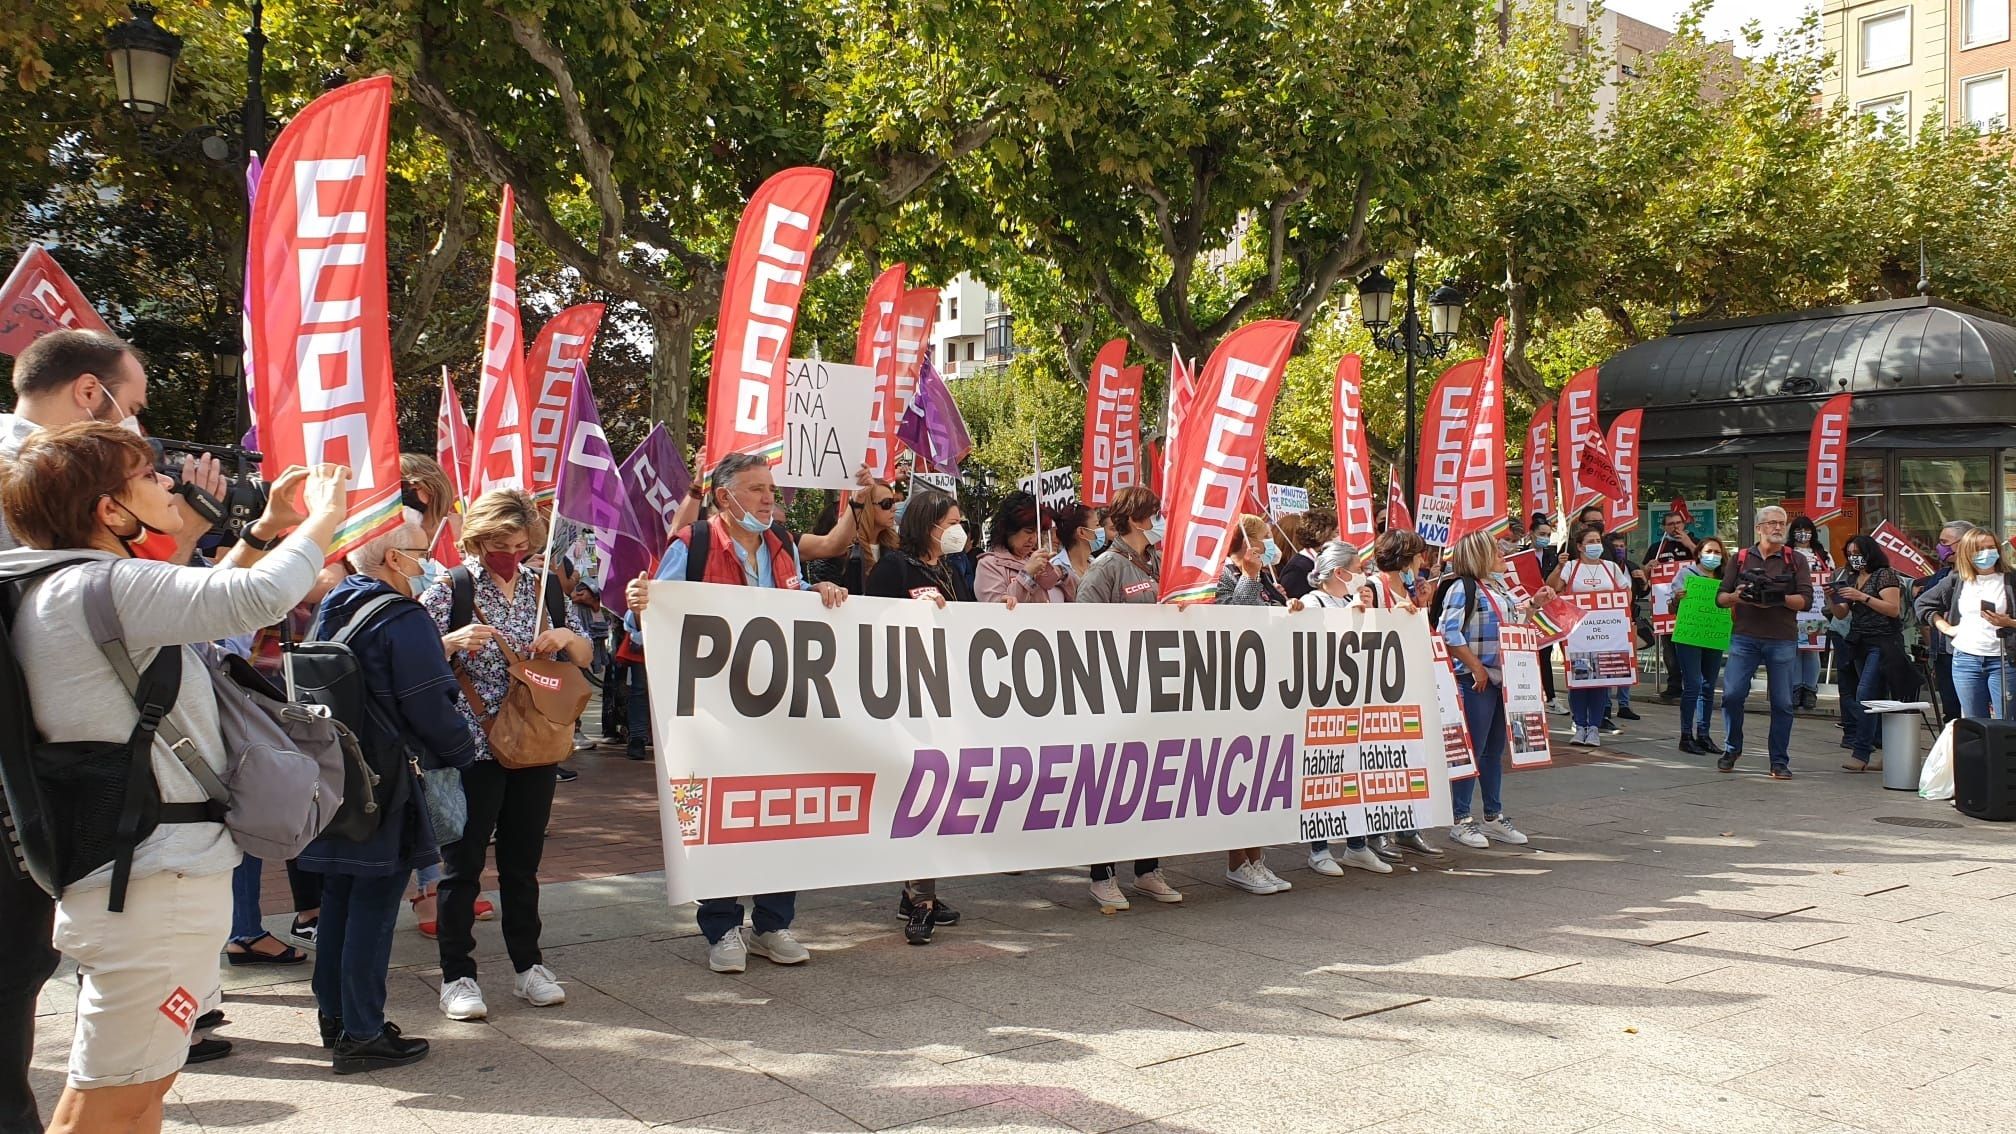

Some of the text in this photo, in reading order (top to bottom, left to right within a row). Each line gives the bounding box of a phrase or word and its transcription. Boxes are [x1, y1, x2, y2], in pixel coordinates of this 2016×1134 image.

[294, 154, 375, 491] CCOO
[734, 202, 810, 435] CCOO
[784, 364, 830, 390] SAD
[786, 422, 849, 479] INA
[1092, 364, 1118, 504] CCOO
[1112, 387, 1135, 491] CCOO
[1181, 356, 1270, 577] CCOO
[1341, 377, 1374, 535] CCOO
[1530, 422, 1549, 514] CCOO
[1816, 414, 1843, 508] CCOO
[1022, 471, 1074, 496] CUDADOS
[1418, 521, 1449, 544] MAYO
[1436, 513, 1450, 525] NUE
[1874, 531, 1925, 566] CCOO
[1125, 582, 1151, 595] CCOO
[1499, 626, 1538, 651] CCOO
[1580, 618, 1622, 626] UALIZACIÓN
[524, 669, 560, 687] CCOO
[677, 614, 1406, 720] POR UN CONVENIO JUSTO
[1308, 712, 1400, 738] CCOO CCOO
[1302, 744, 1408, 776] hábitat hábitat
[889, 733, 1295, 839] DEPENDENCIA
[1304, 771, 1408, 802] CCOO CCOO
[721, 785, 862, 829] CCOO
[1300, 805, 1415, 840] hábitat hábitat
